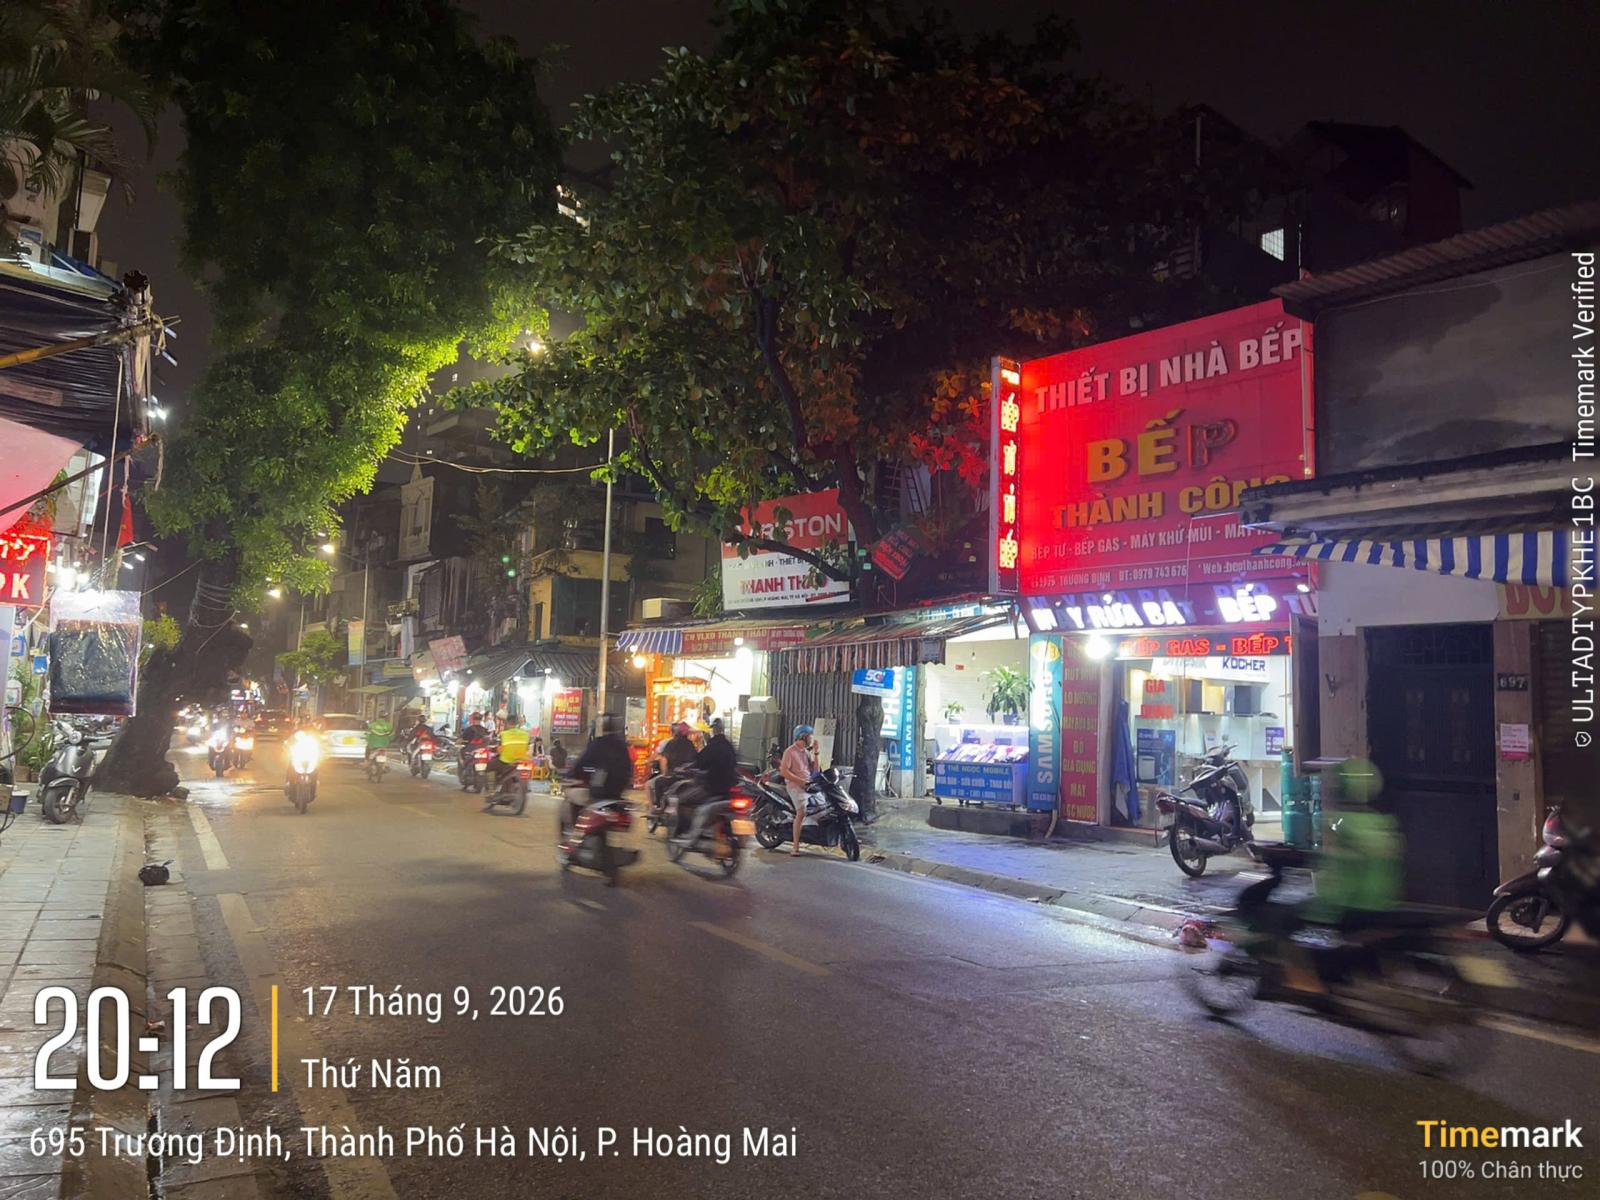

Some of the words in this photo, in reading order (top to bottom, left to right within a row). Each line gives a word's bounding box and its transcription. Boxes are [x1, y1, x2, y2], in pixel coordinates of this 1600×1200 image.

[1035, 366, 1111, 413] THIẾT
[1119, 363, 1149, 397] BỊ
[1160, 340, 1228, 387] NHÀ
[1239, 320, 1303, 371] BẾP
[1087, 408, 1238, 484] BẾP
[1053, 489, 1164, 528] THÀNH
[1179, 475, 1291, 514] CÔN
[735, 513, 841, 546] RSTON
[1098, 537, 1120, 553] GAS
[1217, 583, 1277, 622] BẾP
[1166, 638, 1210, 656] GAS
[1231, 633, 1279, 655] BẾP
[1222, 655, 1266, 672] KOCHER
[1500, 677, 1525, 689] 697
[905, 670, 913, 767] SAMSUNG
